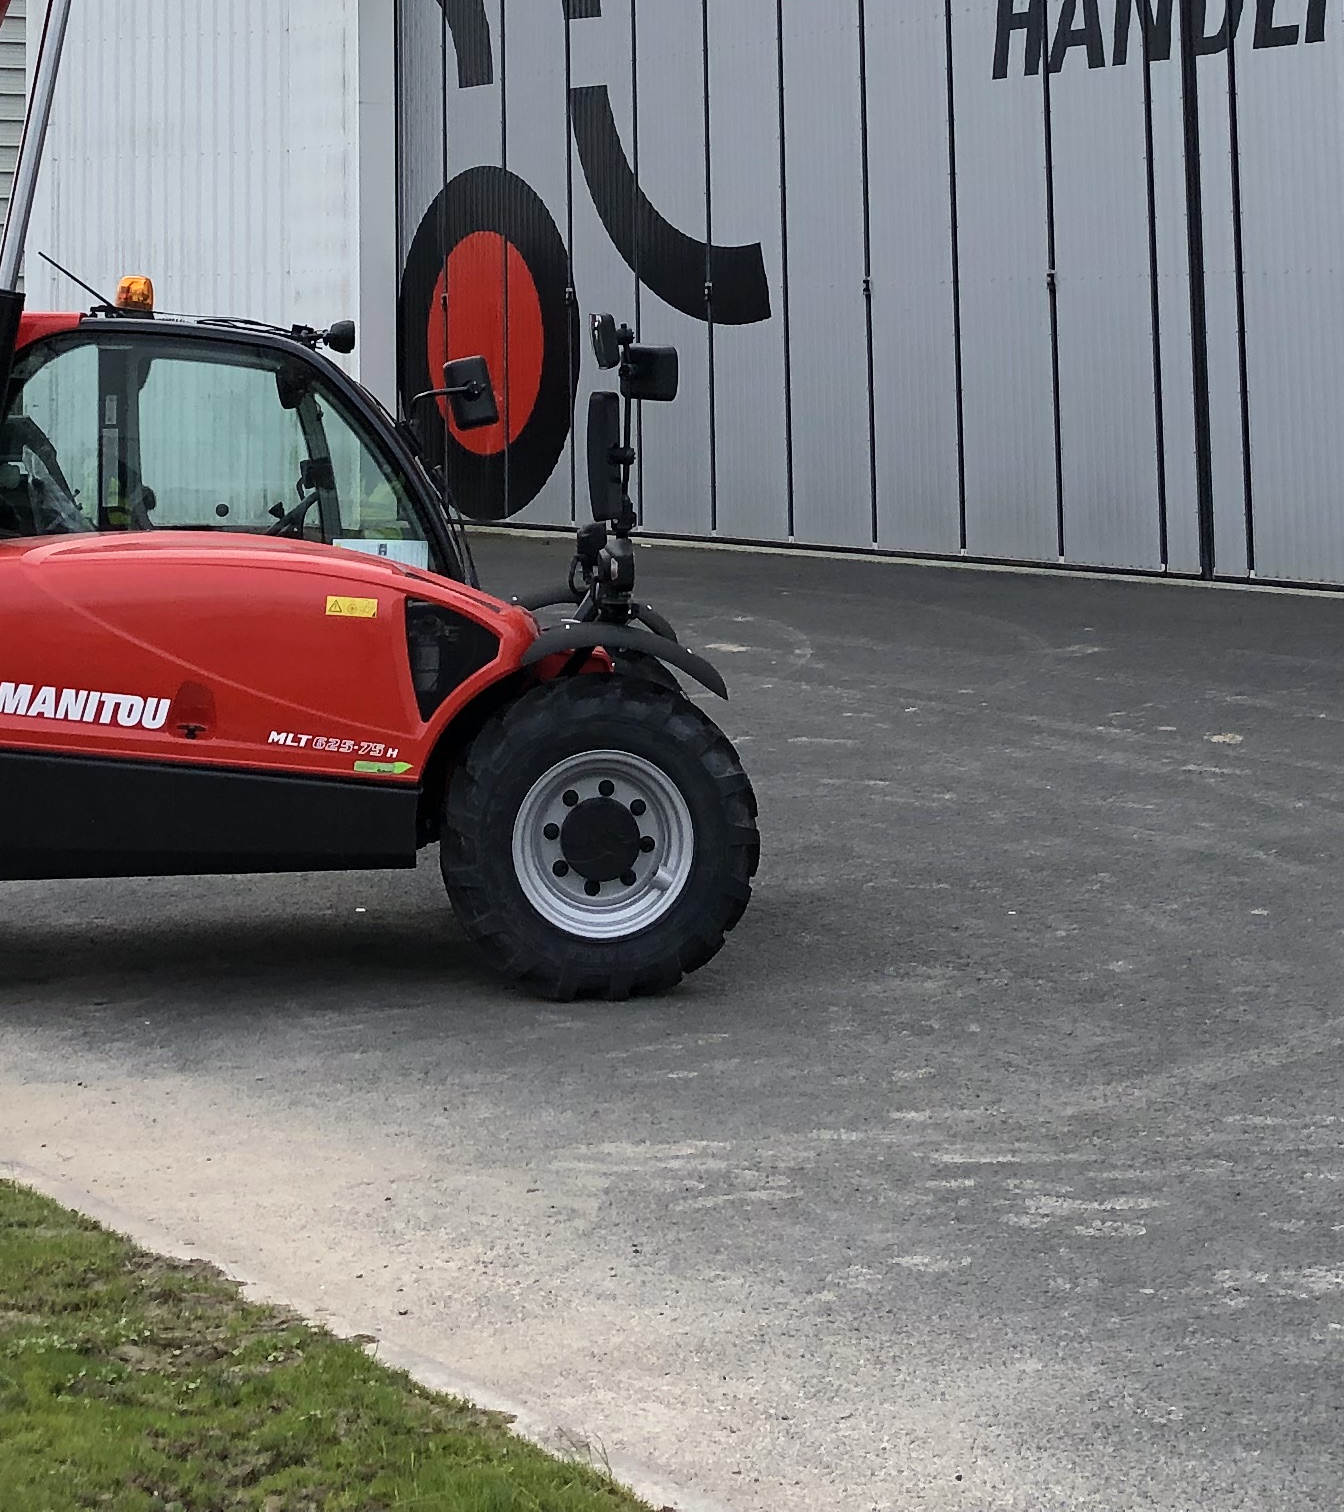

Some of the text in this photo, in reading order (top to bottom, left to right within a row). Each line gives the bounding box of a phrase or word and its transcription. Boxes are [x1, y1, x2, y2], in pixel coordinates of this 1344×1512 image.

[267, 730, 399, 758] MLT 625-75 H
